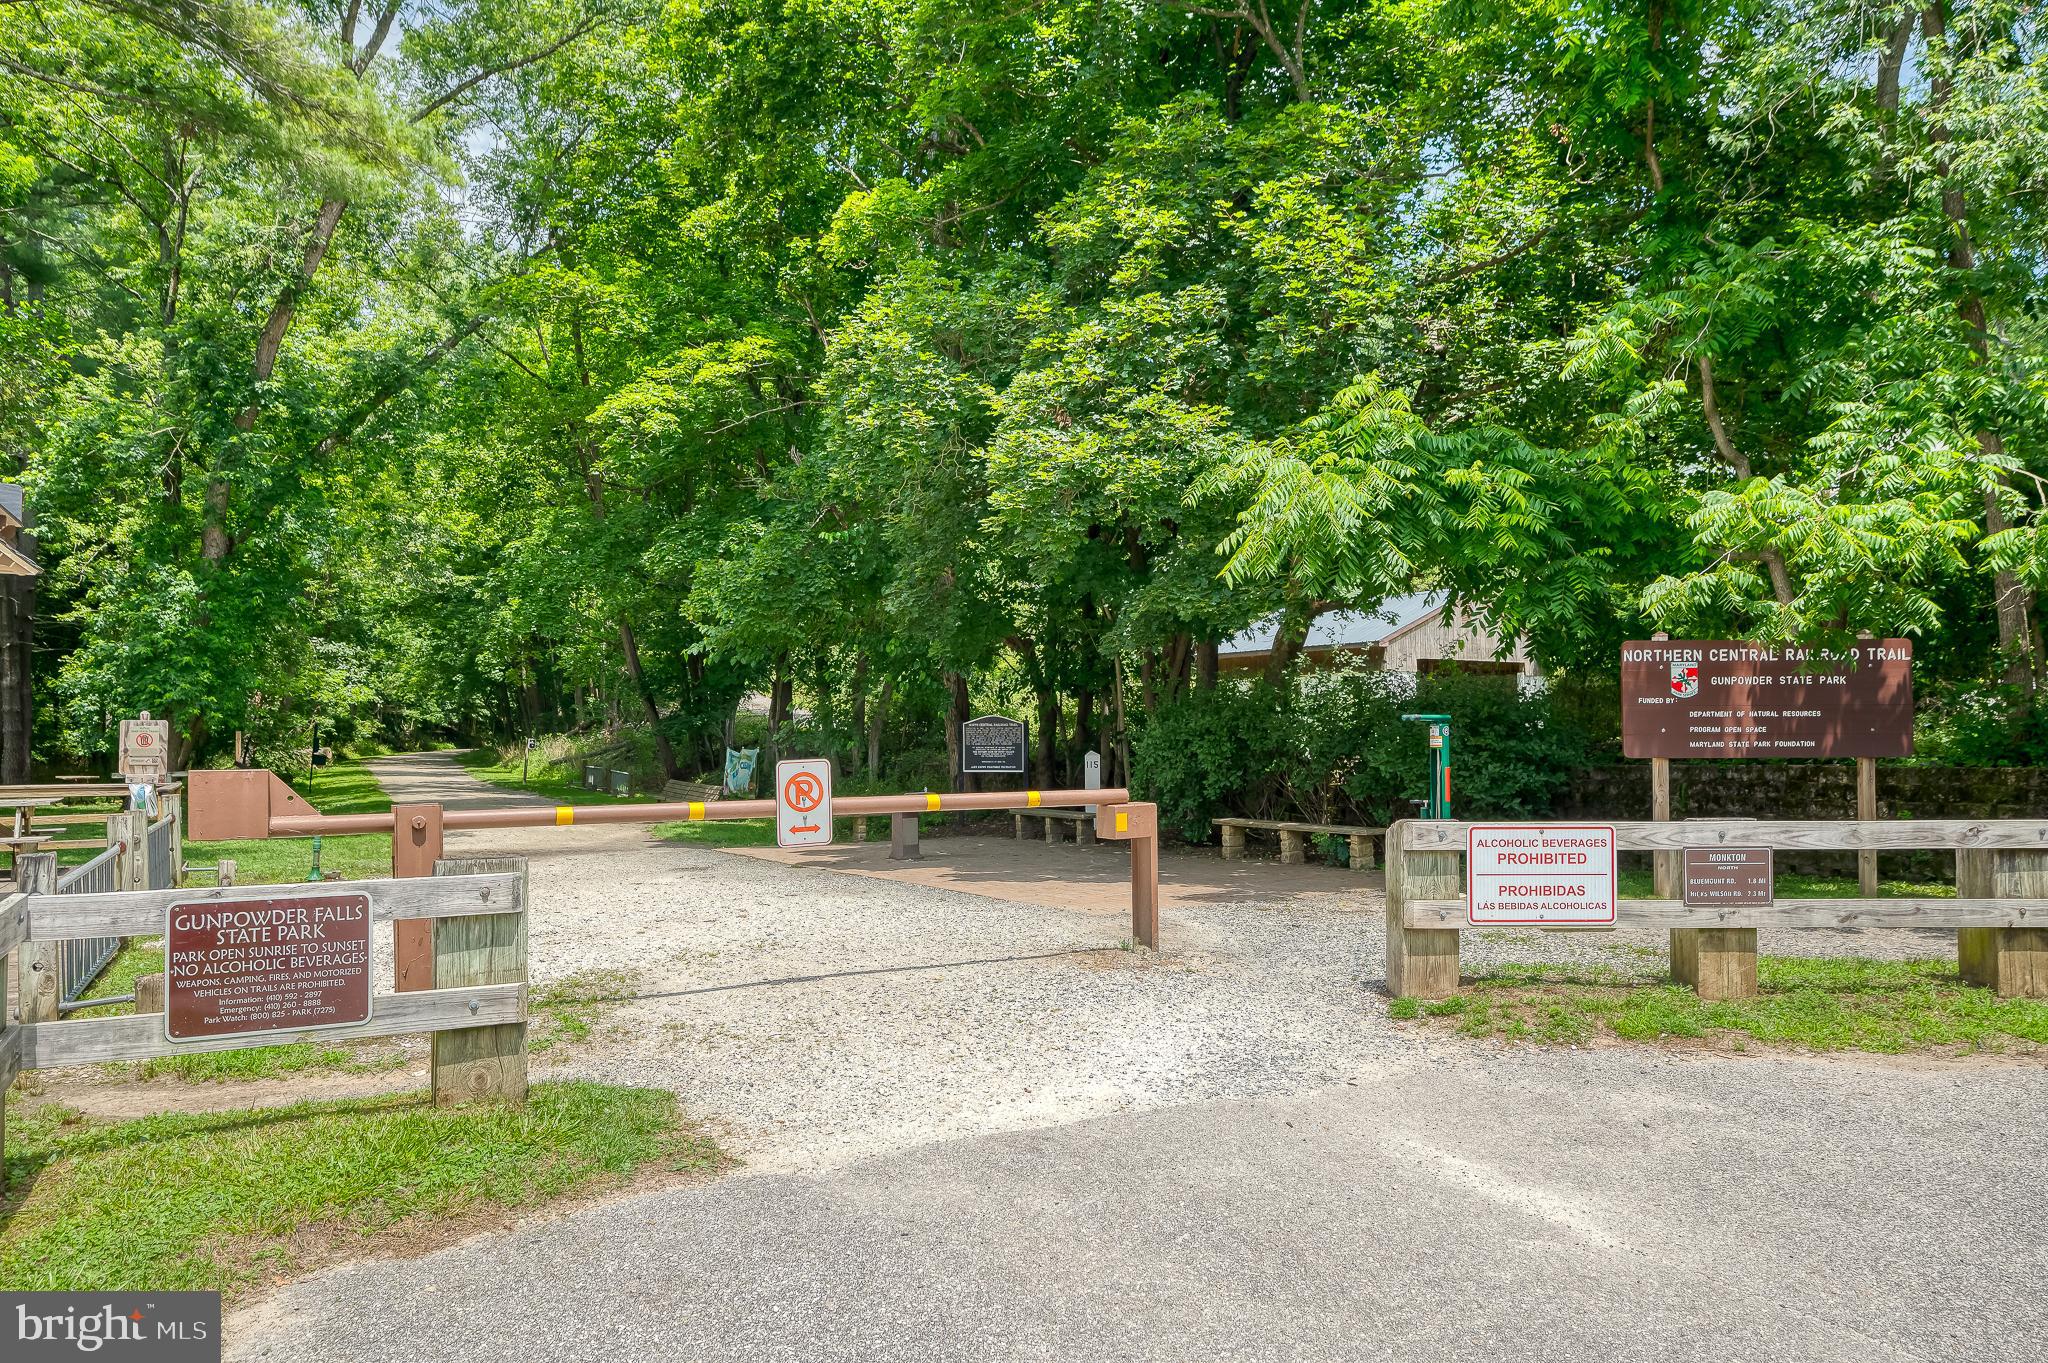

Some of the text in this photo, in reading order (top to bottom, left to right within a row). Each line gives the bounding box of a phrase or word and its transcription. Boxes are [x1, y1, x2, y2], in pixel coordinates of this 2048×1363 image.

[1623, 649, 1703, 662] NORTHERN
[1709, 648, 1778, 662] CENTRAL
[1867, 648, 1911, 660] TRAIL
[1711, 675, 1847, 685] GUNPOWDER STATE PARK
[1086, 760, 1099, 768] 115
[1477, 838, 1607, 848] ALCOHOLIC BEVERAGES
[1497, 853, 1587, 865] PROHIBITED
[1709, 853, 1746, 862] MONKTON
[1498, 885, 1586, 897] PROHIBIDAS
[1498, 902, 1539, 910] BEBIDAS
[1540, 902, 1607, 910] ALCOHOLICAS
[175, 905, 363, 931] GUNPOWDER FALLS
[216, 924, 325, 945] STATE PARK
[173, 940, 366, 963] PARK OPEN SUNRISE TO SUNSET
[173, 952, 365, 977] NO ALCOHOLIC BEVERAGES
[293, 971, 311, 981] AND
[313, 967, 362, 978] MOTORIZED
[194, 979, 346, 998] VEHICLES ON TRAILS ARE PROHIBITED.
[219, 996, 264, 1006] Information:
[266, 993, 283, 1002] (410)
[284, 992, 297, 1000] 592
[219, 1005, 262, 1015] Emergency:
[264, 1002, 281, 1011] (410)
[282, 1001, 297, 1009] 260
[303, 999, 321, 1007] 8888
[204, 1016, 221, 1024] Park
[222, 1013, 248, 1023] Watch:
[250, 1011, 270, 1021] (800)
[271, 1010, 285, 1018] 825
[292, 1008, 312, 1016] PARK
[313, 1006, 335, 1015] (7275)
